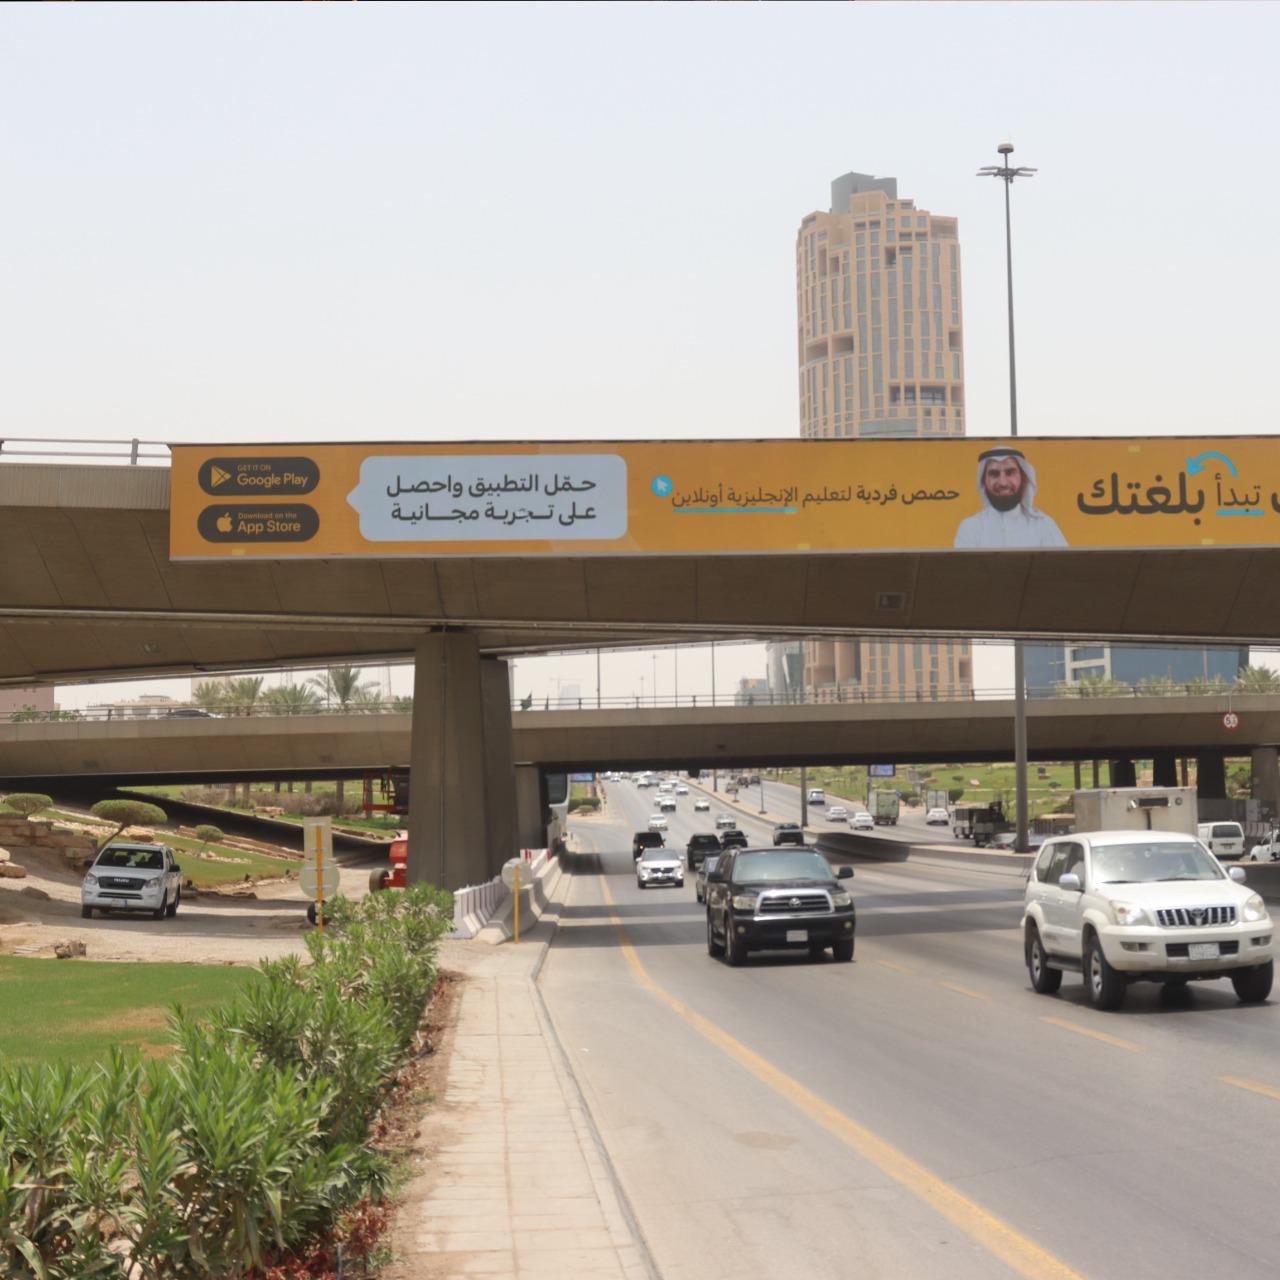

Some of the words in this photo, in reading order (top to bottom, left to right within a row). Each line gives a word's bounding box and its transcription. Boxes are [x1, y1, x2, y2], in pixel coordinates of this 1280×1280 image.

[237, 464, 252, 472] GET
[259, 464, 271, 472] ON
[237, 473, 281, 488] Google
[283, 472, 308, 488] Play
[386, 474, 463, 498] واحصل
[468, 473, 539, 497] التطبيق
[672, 483, 723, 508] أونلاين
[727, 486, 798, 508] الإنجليزية
[802, 486, 852, 508] لتعليم
[856, 484, 897, 506] فردية
[901, 488, 960, 505] حصص
[1077, 472, 1205, 526] بلغتك
[1215, 473, 1262, 513] تبدأ
[391, 502, 480, 526] مجانية
[484, 502, 554, 525] تجربة
[558, 501, 596, 525] على
[237, 521, 264, 534] App
[266, 520, 301, 532] Store
